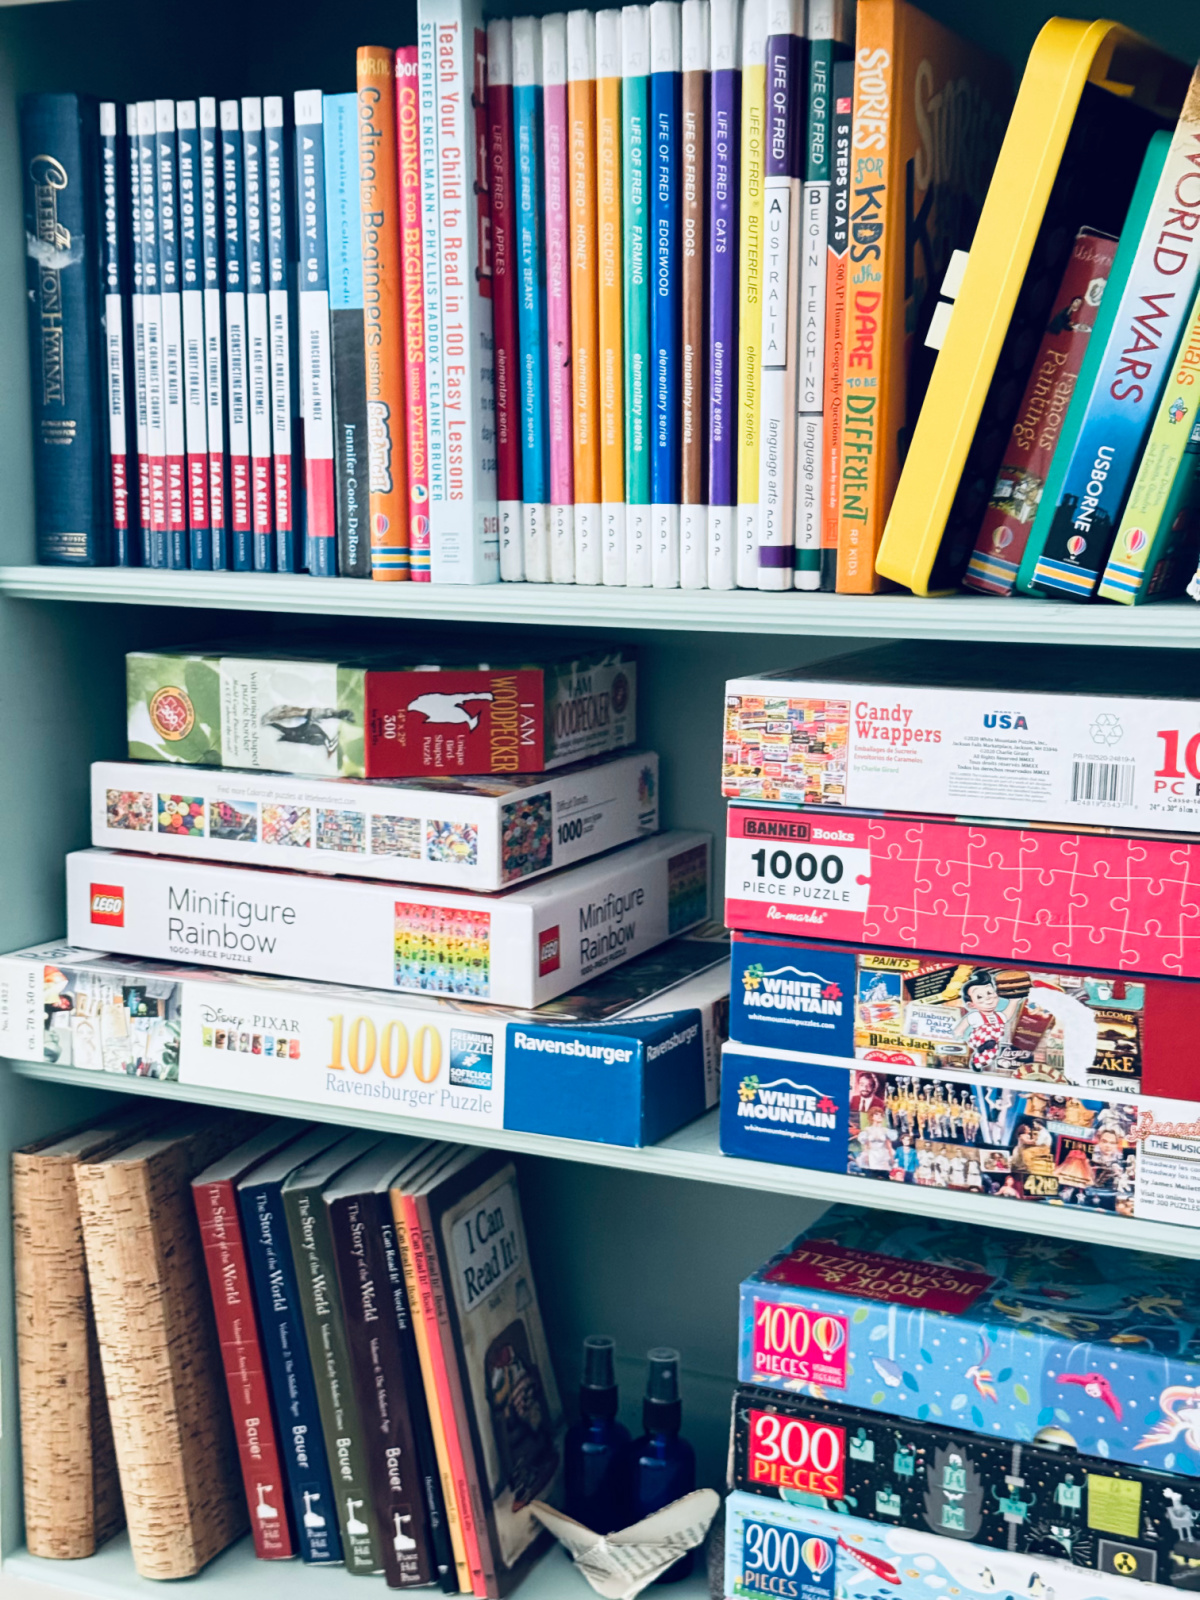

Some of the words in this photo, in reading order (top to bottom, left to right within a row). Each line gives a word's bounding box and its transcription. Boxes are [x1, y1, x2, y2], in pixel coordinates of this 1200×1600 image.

[421, 24, 432, 108] SIEGFRIED
[439, 22, 458, 82] Teach
[774, 55, 786, 88] LIFE
[441, 92, 460, 137] Your
[774, 93, 786, 113] OF
[360, 87, 384, 181] Coding
[400, 88, 418, 188] CODING
[659, 113, 668, 140] LIFE
[717, 111, 727, 138] LIFE
[749, 107, 759, 135] LIFE
[773, 118, 785, 159] FRED
[838, 125, 848, 133] 5
[423, 116, 435, 213] ENGELMANN
[659, 145, 668, 162] OF
[717, 143, 726, 160] OF
[749, 139, 759, 157] OF
[836, 139, 848, 186] STEPS
[443, 147, 461, 199] Child
[659, 166, 668, 201] FRED
[717, 165, 726, 200] FRED
[748, 161, 758, 197] FRED
[225, 160, 238, 242] HISTORY
[304, 155, 316, 239] HISTORY
[363, 185, 376, 207] for
[406, 193, 416, 223] FOR
[835, 191, 847, 208] TO
[443, 209, 461, 227] to
[835, 216, 845, 227] A
[716, 219, 725, 253] CATS
[834, 232, 845, 240] 5
[229, 260, 239, 284] US
[308, 258, 318, 282] US
[426, 230, 437, 295] PHYLLIS
[444, 237, 463, 286] Read
[659, 219, 668, 296] EDGEWOOD
[748, 216, 758, 303] BUTTERFLIES
[836, 263, 845, 279] 500
[364, 210, 385, 346] Beginners
[404, 228, 423, 363] BEGINNERS
[836, 283, 845, 297] AP
[446, 295, 462, 313] in
[834, 303, 843, 339] Human
[427, 302, 439, 363] HADDOX
[446, 323, 463, 356] 100
[849, 291, 881, 369] DARE
[42, 312, 64, 402] HYMNAL
[231, 325, 242, 388] RECONSTRUCTING
[311, 330, 320, 379] SOURCEBOOK
[1110, 292, 1176, 404] WARS
[370, 351, 381, 395] using
[411, 368, 420, 400] USING
[658, 349, 668, 411] elementary
[712, 342, 723, 404] elementary
[745, 346, 756, 409] elementary
[831, 342, 842, 394] Geography
[847, 378, 860, 387] TO
[862, 378, 877, 387] BE
[444, 366, 465, 410] Easy
[1012, 349, 1068, 451] Paintings
[234, 392, 243, 423] AMERICA
[313, 398, 321, 421] INDEX
[430, 383, 441, 436] ELAINE
[714, 407, 723, 441] series
[831, 397, 841, 446] Questions
[1038, 372, 1077, 451] Famous
[411, 405, 423, 478] PYTHON
[659, 414, 668, 447] series
[746, 413, 755, 446] series
[344, 424, 356, 474] Jennifer
[449, 421, 466, 500] Lessons
[767, 419, 779, 477] language
[843, 395, 876, 525] DIFFERENT
[432, 443, 442, 501] BRUNER
[1074, 446, 1115, 533] USBORNE
[192, 462, 203, 520] HAKIM
[235, 465, 246, 523] HAKIM
[276, 464, 287, 522] HAKIM
[768, 481, 777, 504] arts
[347, 478, 358, 565] Cook-DeRosa
[849, 529, 859, 544] RP
[848, 549, 858, 576] KIDS
[384, 715, 396, 739] 300
[491, 676, 518, 771] WOODPECKER
[521, 714, 535, 745] AM
[855, 702, 913, 727] Candy
[983, 714, 1028, 730] USA
[855, 721, 942, 746] Wrappers
[747, 821, 807, 838] BANNED
[812, 828, 854, 841] Books
[751, 848, 844, 884] 1000
[92, 896, 122, 914] LEGO
[169, 886, 295, 927] Minifigure
[743, 882, 786, 895] PIECE
[793, 886, 850, 902] PUZZLE
[580, 888, 644, 932] Minifigure
[766, 906, 824, 924] Re-marks
[169, 918, 276, 953] Rainbow
[580, 922, 635, 965] Rainbow
[170, 946, 217, 958] 1000-PIECE
[220, 952, 252, 963] PUZZLE
[872, 957, 911, 968] PAINTS
[743, 991, 842, 1016] MOUNTAIN
[762, 978, 822, 998] WHITE
[252, 1016, 301, 1032] PIXAR
[451, 1029, 493, 1045] PREMIUM
[748, 1013, 835, 1029] whitemountainpuzzles.com
[326, 1014, 443, 1084] 1000
[451, 1041, 493, 1056] PUZZLE
[514, 1032, 633, 1065] Ravensburger
[646, 1024, 699, 1063] Ravensburger
[870, 1033, 905, 1047] Black
[906, 1040, 936, 1051] Jack
[450, 1069, 492, 1081] SOFTCLICK
[325, 1072, 435, 1108] Ravensburger
[441, 1088, 493, 1115] Puzzle
[758, 1089, 816, 1110] WHITE
[737, 1102, 836, 1129] MOUNTAIN
[256, 1193, 267, 1212] The
[347, 1202, 359, 1222] The
[259, 1212, 275, 1245] Story
[350, 1222, 367, 1256] Story
[465, 1222, 475, 1254] I
[475, 1205, 505, 1247] Can
[463, 1249, 501, 1304] Read
[498, 1231, 519, 1277] It!
[791, 1250, 883, 1279] PUZZLE
[268, 1270, 287, 1312] World
[852, 1277, 929, 1298] BOOK
[890, 1271, 983, 1295] JIGSAW
[359, 1280, 378, 1322] World
[757, 1305, 810, 1357] 100
[756, 1352, 809, 1379] PIECES
[292, 1425, 310, 1468] Bauer
[755, 1415, 839, 1473] 300
[385, 1447, 404, 1492] Bauer
[754, 1459, 839, 1495] PIECES
[745, 1524, 799, 1577] 300
[744, 1570, 798, 1597] PIECES
